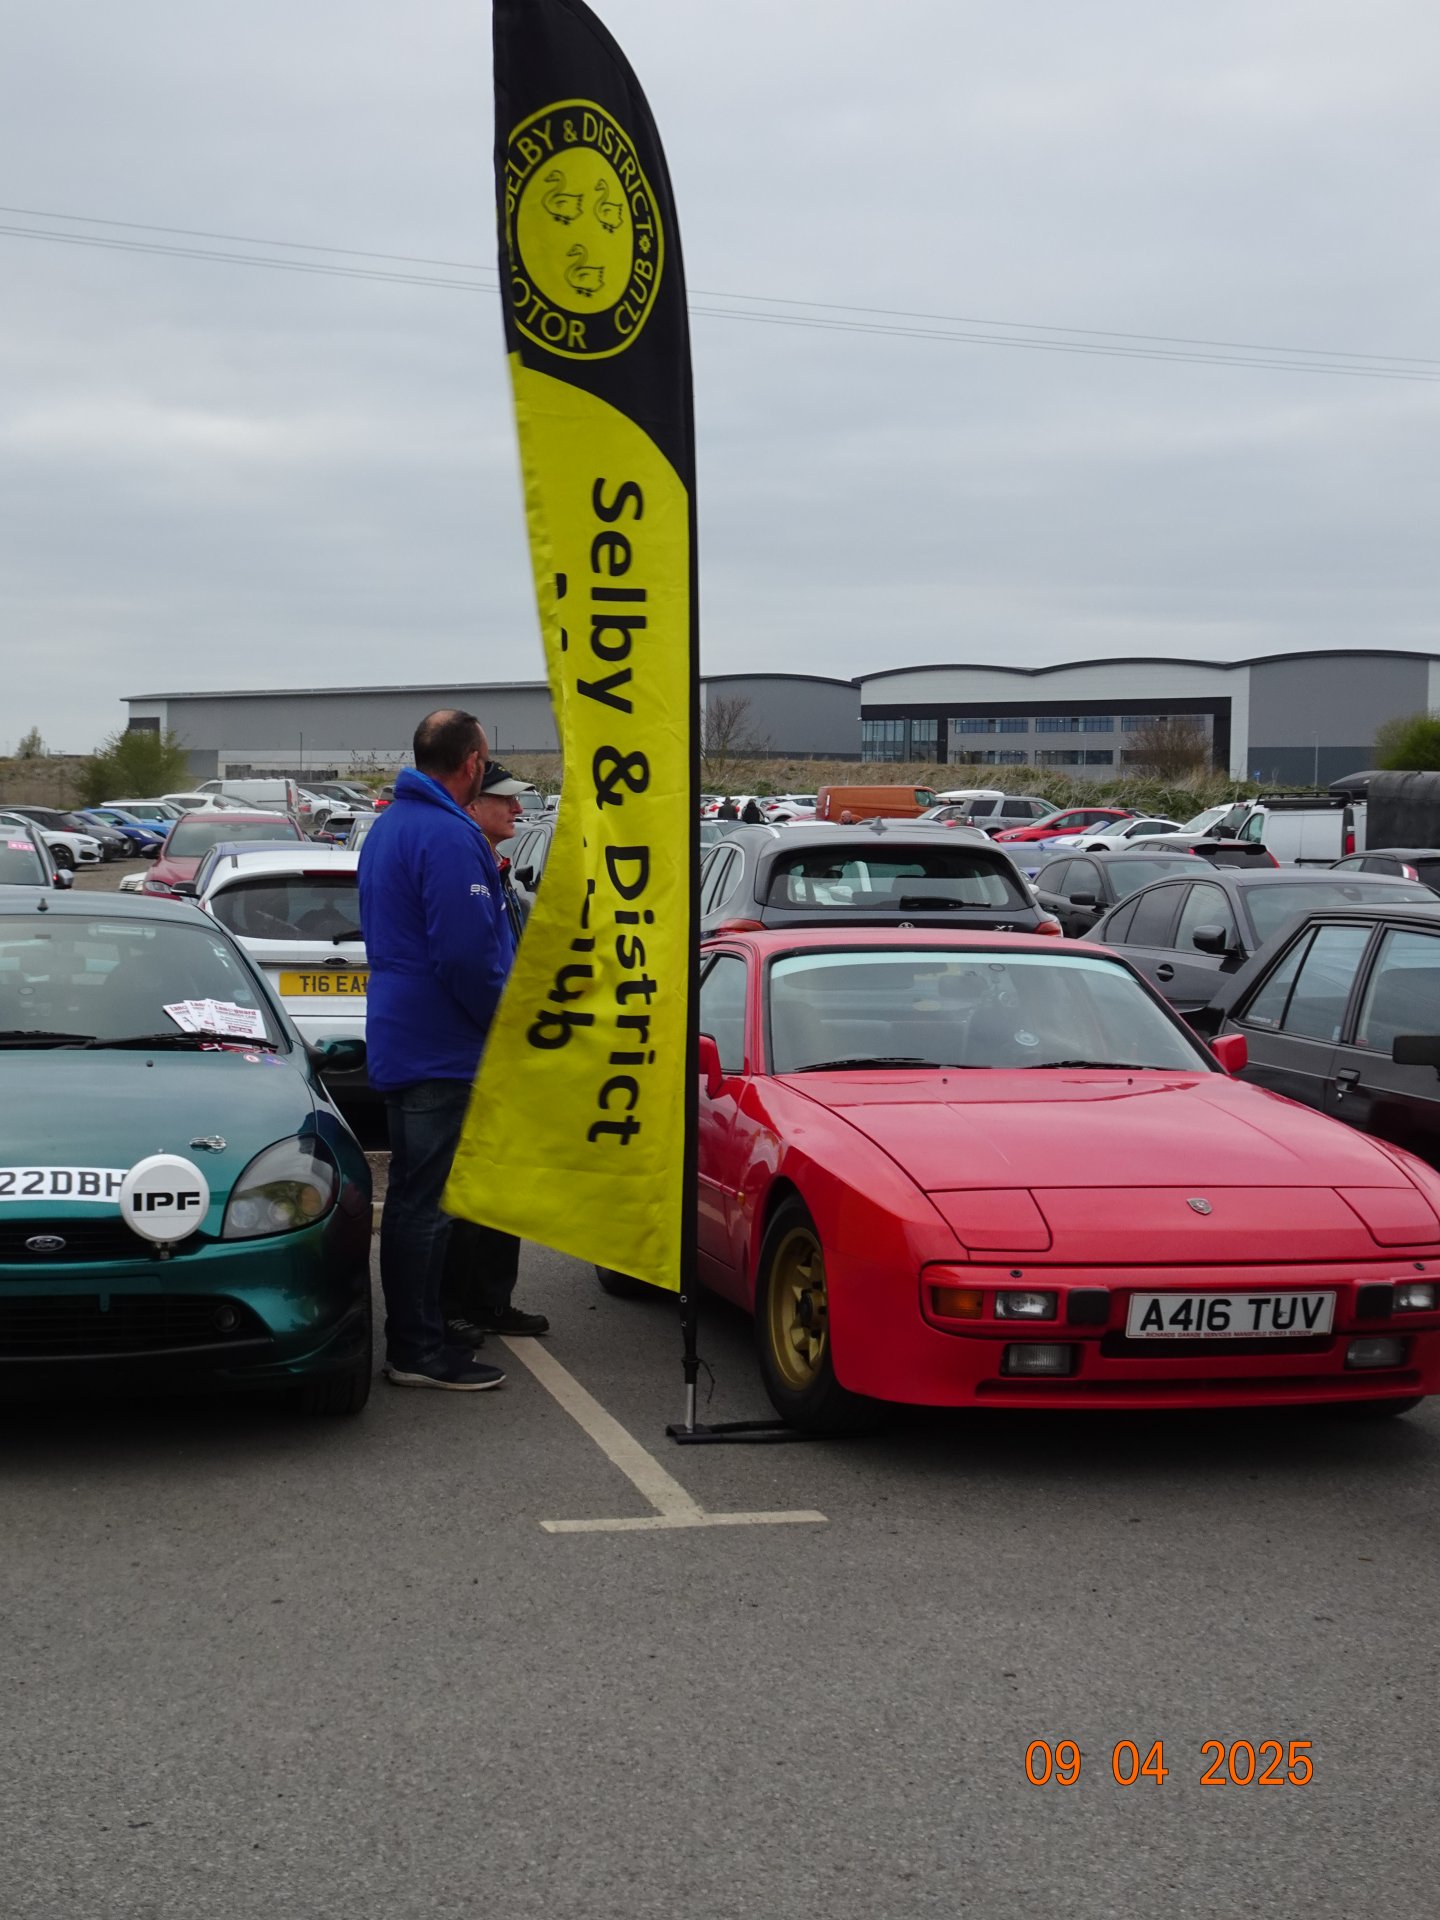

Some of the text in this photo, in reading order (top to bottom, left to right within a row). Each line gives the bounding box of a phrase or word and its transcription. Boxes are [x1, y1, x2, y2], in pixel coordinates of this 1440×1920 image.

[563, 119, 578, 143] &
[583, 111, 654, 238] DISTRICT
[511, 259, 654, 350] OTOR CLUB
[577, 477, 657, 1146] Selby & District
[133, 1191, 201, 1212] IPF
[1139, 1296, 1325, 1332] A416 TUV
